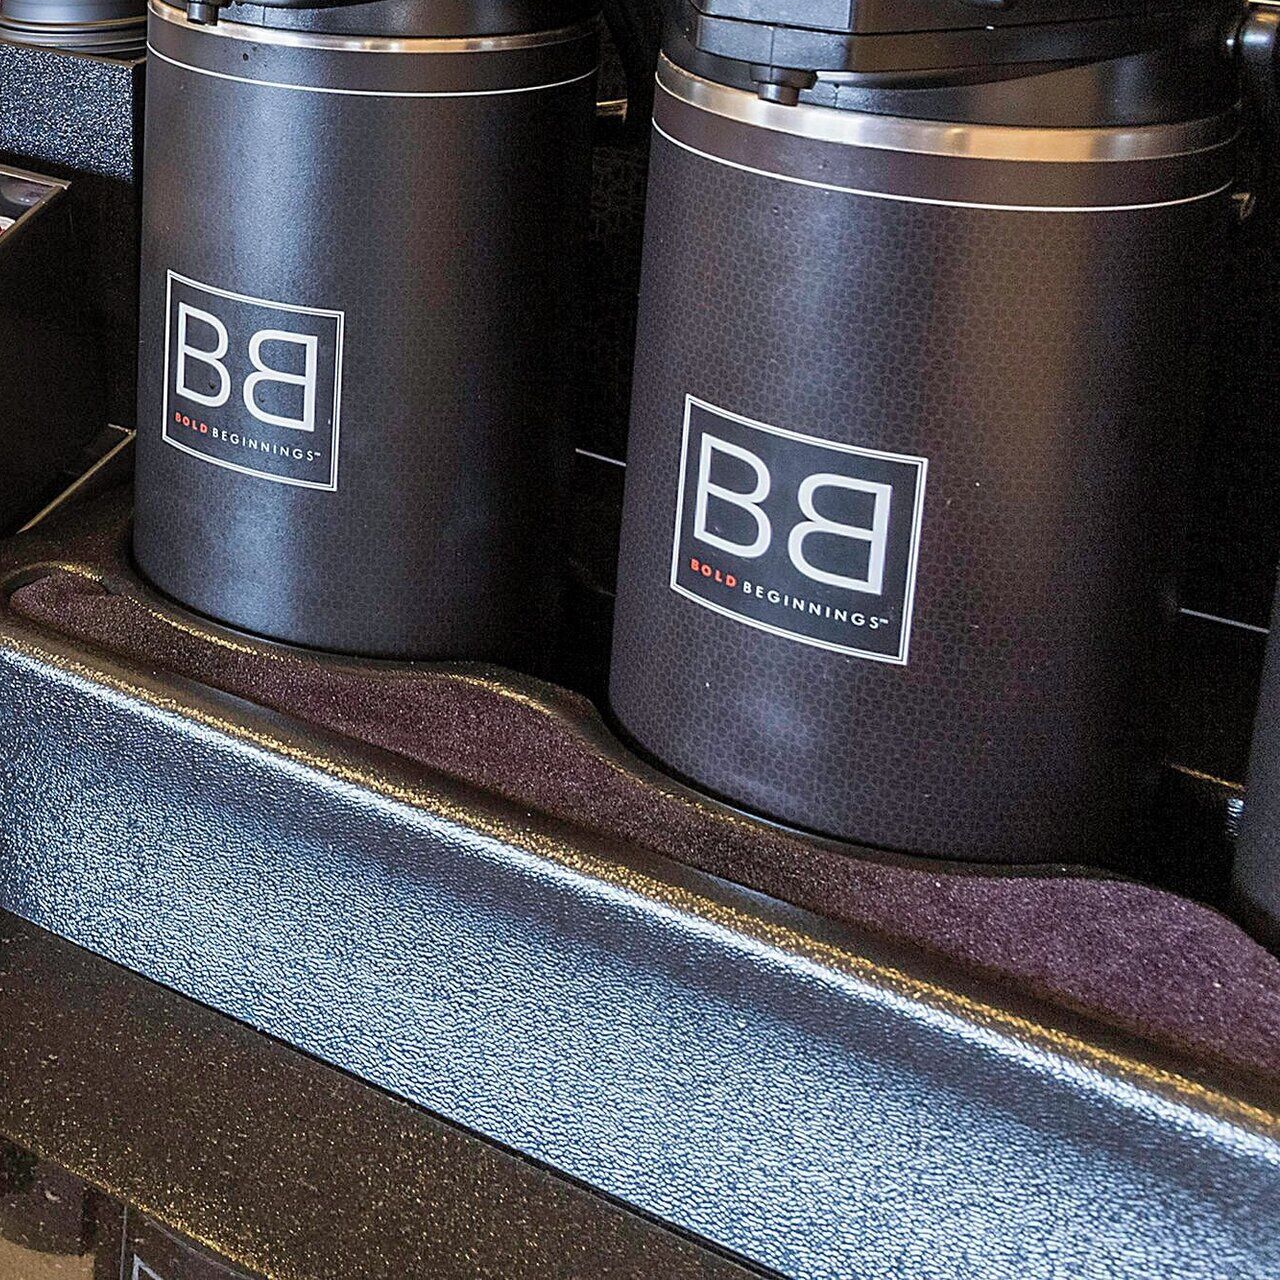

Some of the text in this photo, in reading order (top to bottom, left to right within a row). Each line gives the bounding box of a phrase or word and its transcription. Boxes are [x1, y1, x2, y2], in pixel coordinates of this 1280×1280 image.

[174, 411, 316, 462] BOLD BEGINNINGS
[688, 557, 881, 631] BOLD BEGINNINGS
